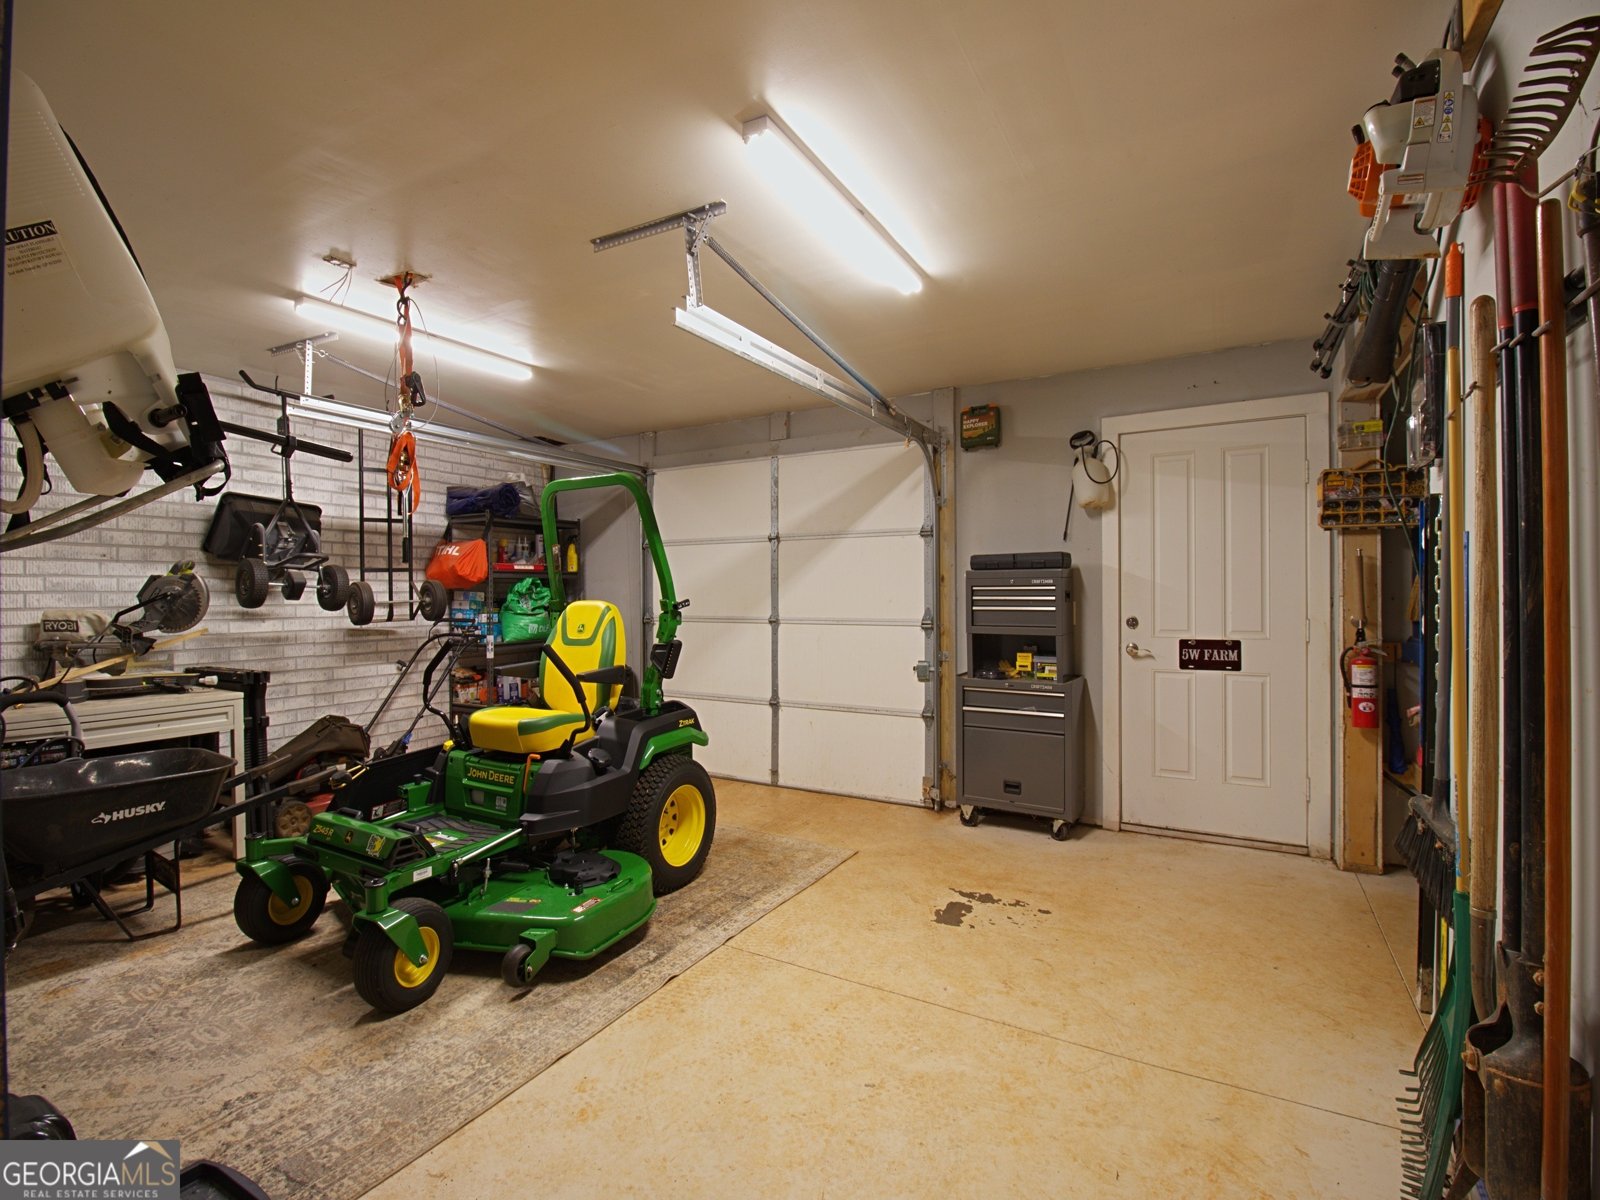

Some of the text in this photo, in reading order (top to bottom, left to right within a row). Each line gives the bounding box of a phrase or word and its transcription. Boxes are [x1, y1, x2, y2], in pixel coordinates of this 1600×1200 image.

[44, 621, 77, 631] RYOBI
[1182, 648, 1239, 661] 5W FARM
[467, 767, 515, 785] JOHN DEERE
[112, 801, 166, 821] HUSKY
